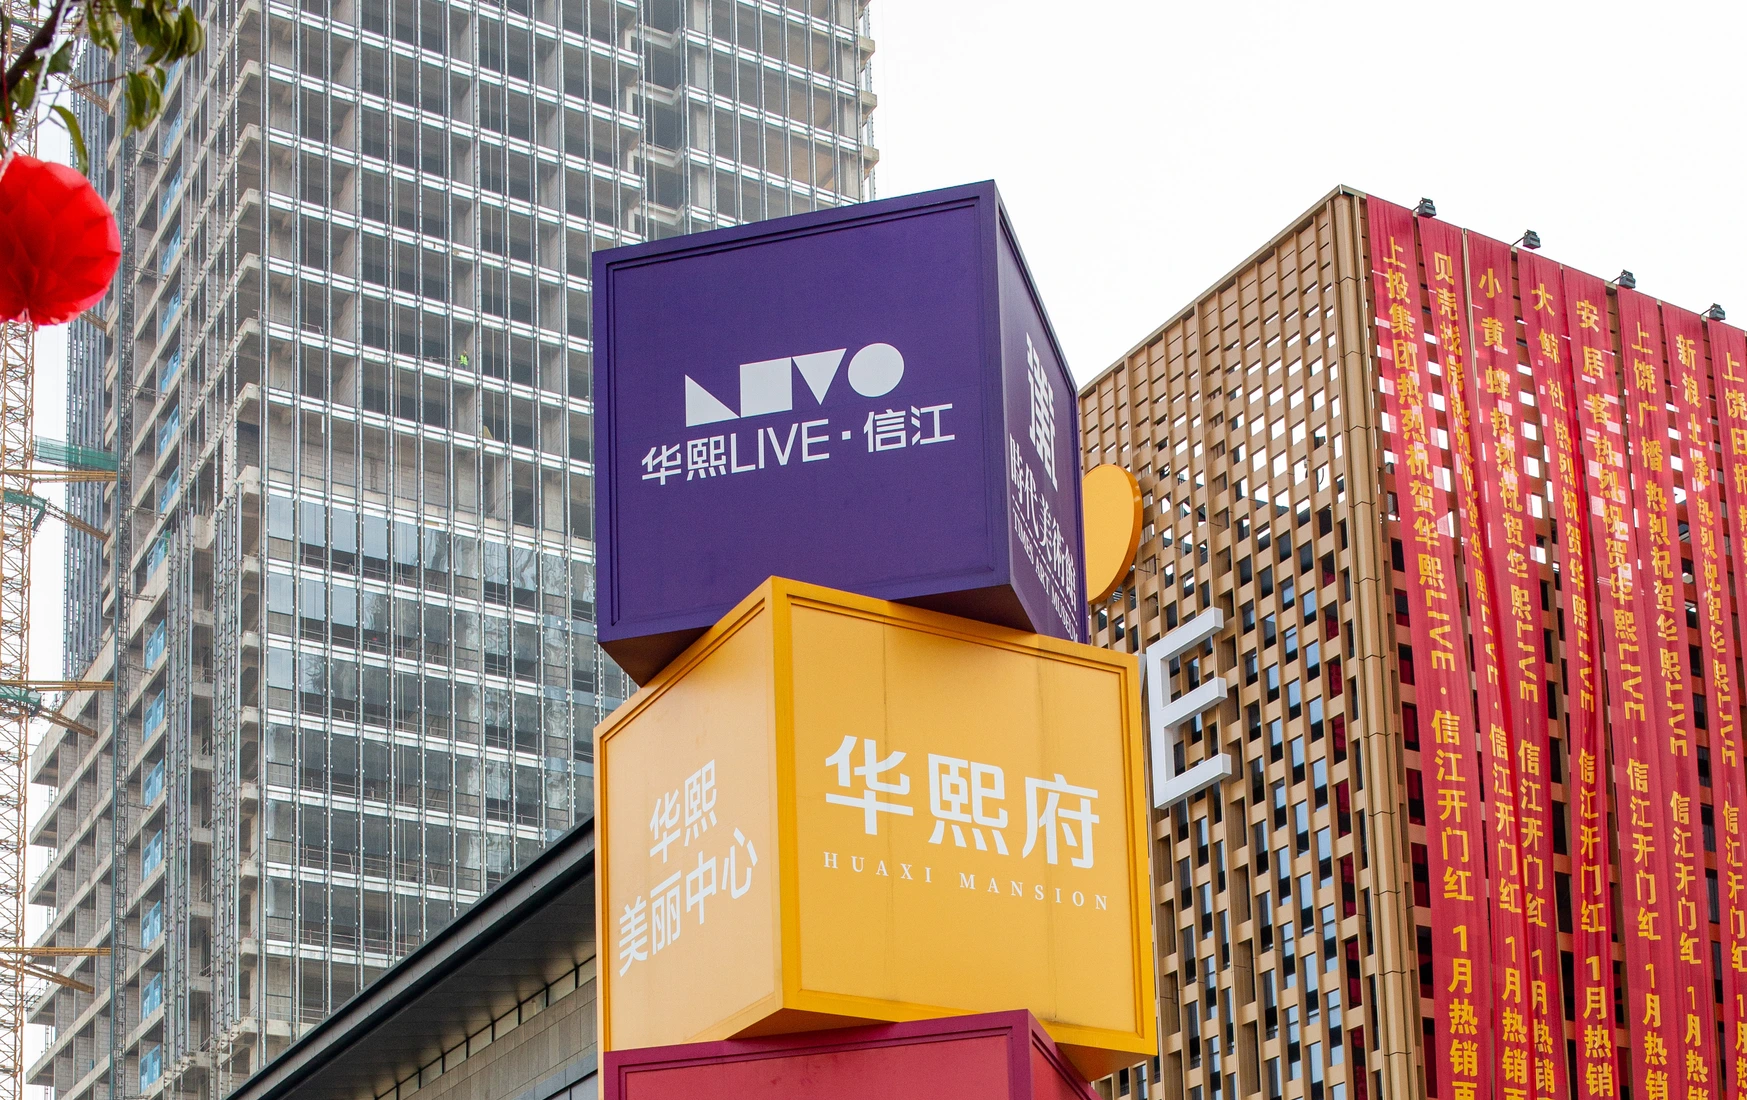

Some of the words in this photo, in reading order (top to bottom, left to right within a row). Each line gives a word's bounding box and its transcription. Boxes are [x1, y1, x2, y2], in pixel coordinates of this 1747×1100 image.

[1013, 507, 1035, 566] TIMES
[1035, 556, 1050, 595] ART
[1051, 590, 1078, 643] MUSEUM
[649, 758, 718, 864] 华熙
[825, 735, 1101, 869] 华熙府
[618, 827, 758, 977] 美丽中心
[823, 851, 933, 884] HUAXI
[959, 872, 1108, 911] MANSION
